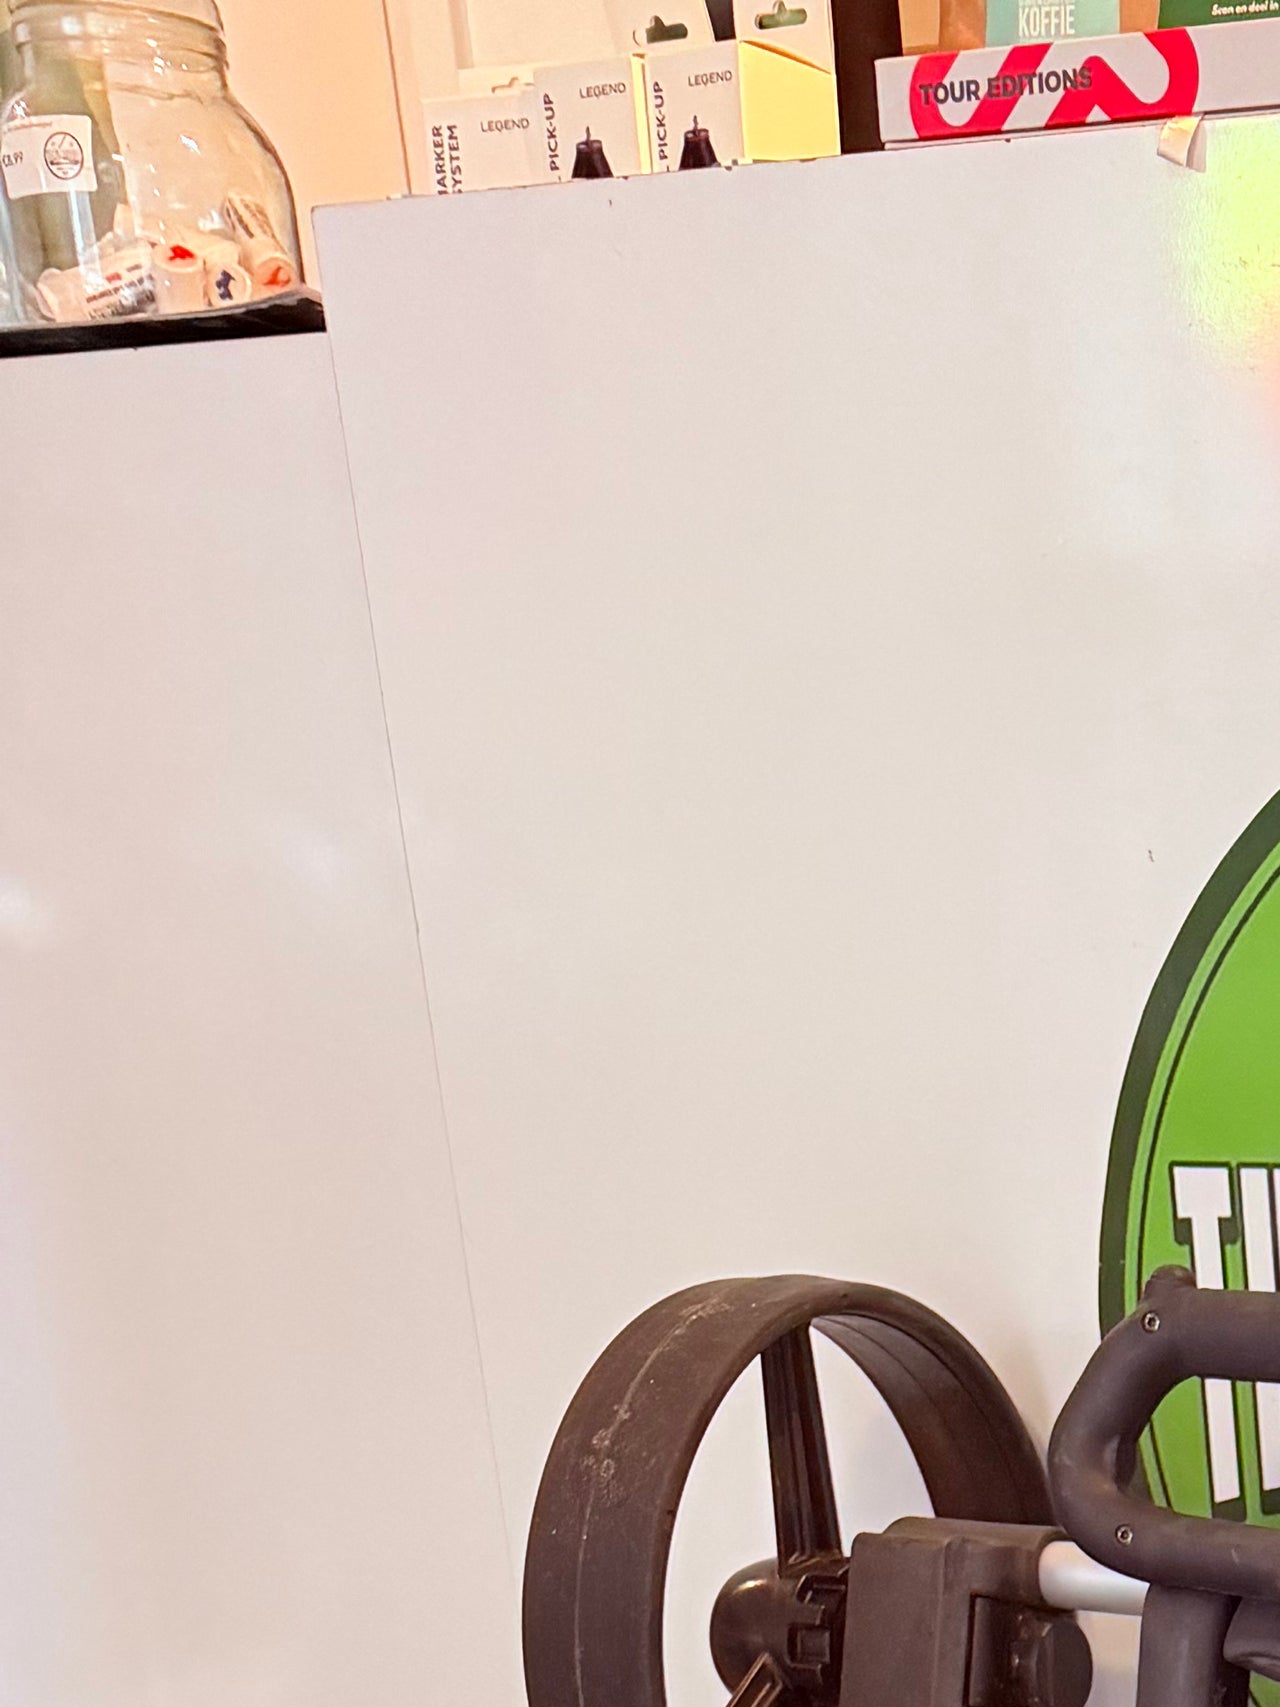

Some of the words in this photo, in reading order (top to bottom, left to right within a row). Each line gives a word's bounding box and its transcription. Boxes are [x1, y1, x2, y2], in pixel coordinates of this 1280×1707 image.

[1018, 4, 1076, 38] KOFFIE
[919, 79, 981, 106] TOUR
[987, 66, 1092, 98] EDITIONS
[543, 93, 559, 171] PICK-UP
[653, 81, 668, 160] PICK-UP
